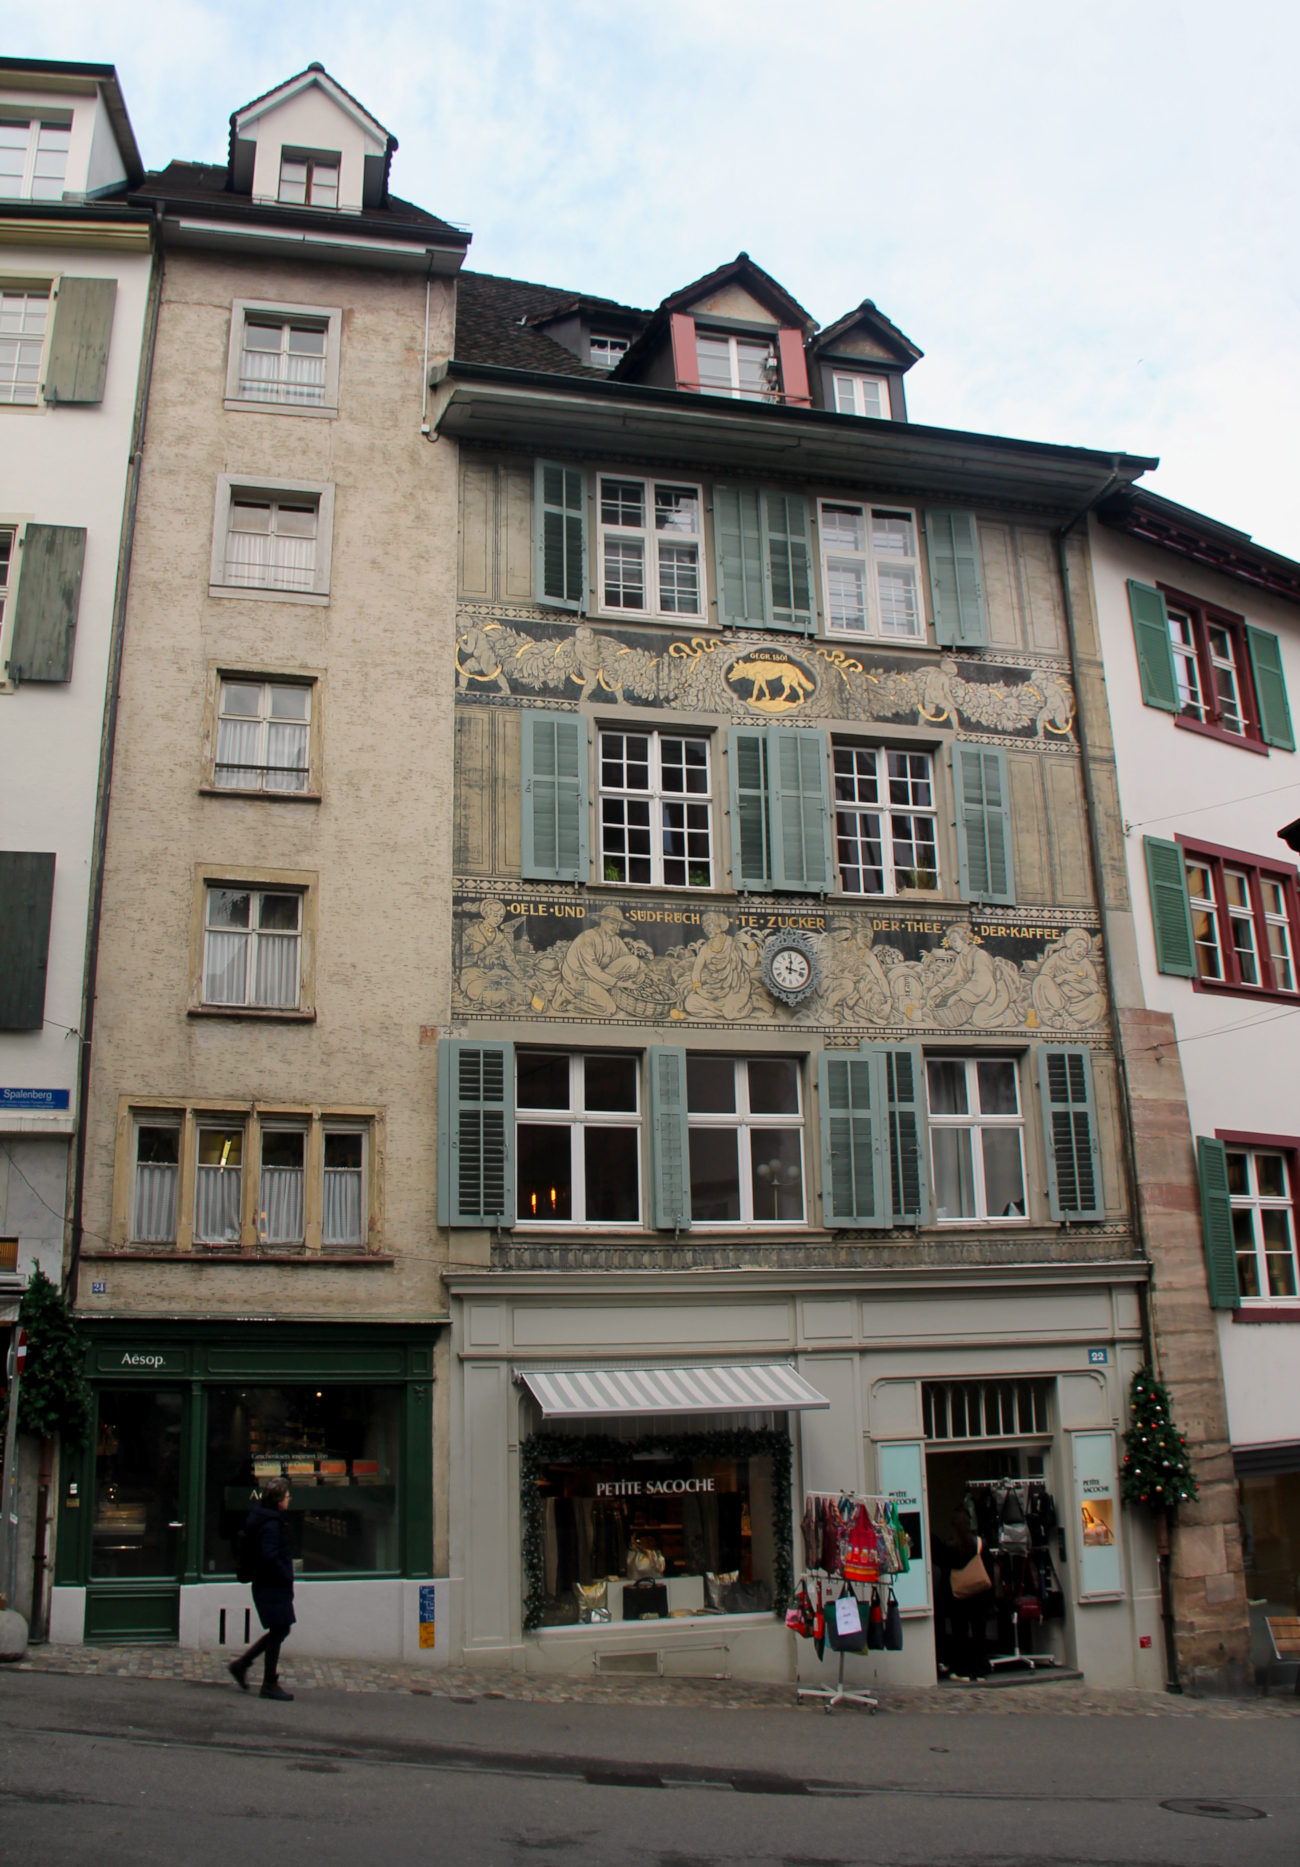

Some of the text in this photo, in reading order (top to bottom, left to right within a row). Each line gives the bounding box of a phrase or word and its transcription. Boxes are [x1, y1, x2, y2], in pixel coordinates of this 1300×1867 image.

[554, 905, 586, 919] UND
[766, 916, 826, 929] ZUCKER
[873, 920, 900, 931] DER
[904, 921, 943, 934] THEE
[980, 925, 1007, 937] DER
[1010, 926, 1061, 940] KAFFEE
[3, 1089, 52, 1101] Spalenberg
[1091, 1351, 1105, 1361] 22
[646, 1478, 715, 1494] SACOCHE
